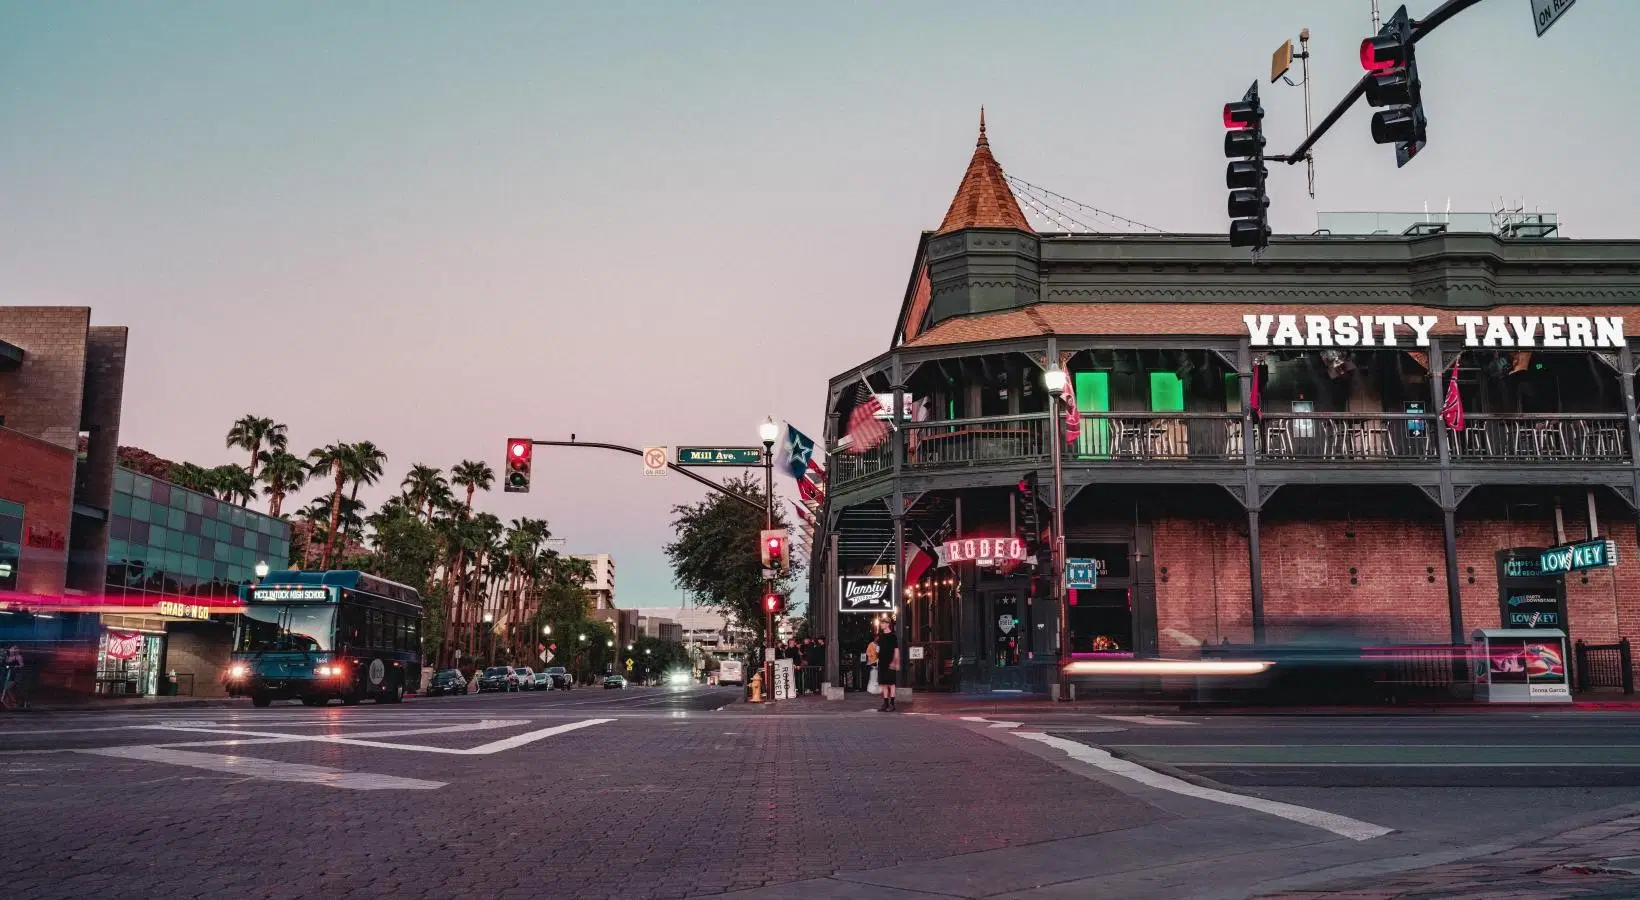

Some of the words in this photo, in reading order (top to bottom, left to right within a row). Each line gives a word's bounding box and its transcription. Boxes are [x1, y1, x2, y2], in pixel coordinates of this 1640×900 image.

[1539, 5, 1551, 26] ON
[1243, 314, 1438, 347] VARSITY
[1456, 315, 1627, 348] TAVERN
[690, 451, 712, 460] Mill
[716, 452, 736, 460] Ave.
[950, 538, 1022, 561] RODEO
[1542, 551, 1570, 573] LOW
[1574, 543, 1602, 568] KEY
[1096, 560, 1105, 569] 01
[254, 590, 290, 599] MCCLINTOCK
[290, 590, 304, 599] HIGH
[304, 590, 326, 599] SCHOOL
[846, 580, 888, 599] Varsity
[161, 601, 184, 616] GRAB
[198, 606, 209, 619] GO
[1512, 614, 1531, 623] LOW
[1537, 613, 1554, 623] KEY
[782, 666, 790, 690] ROAD
